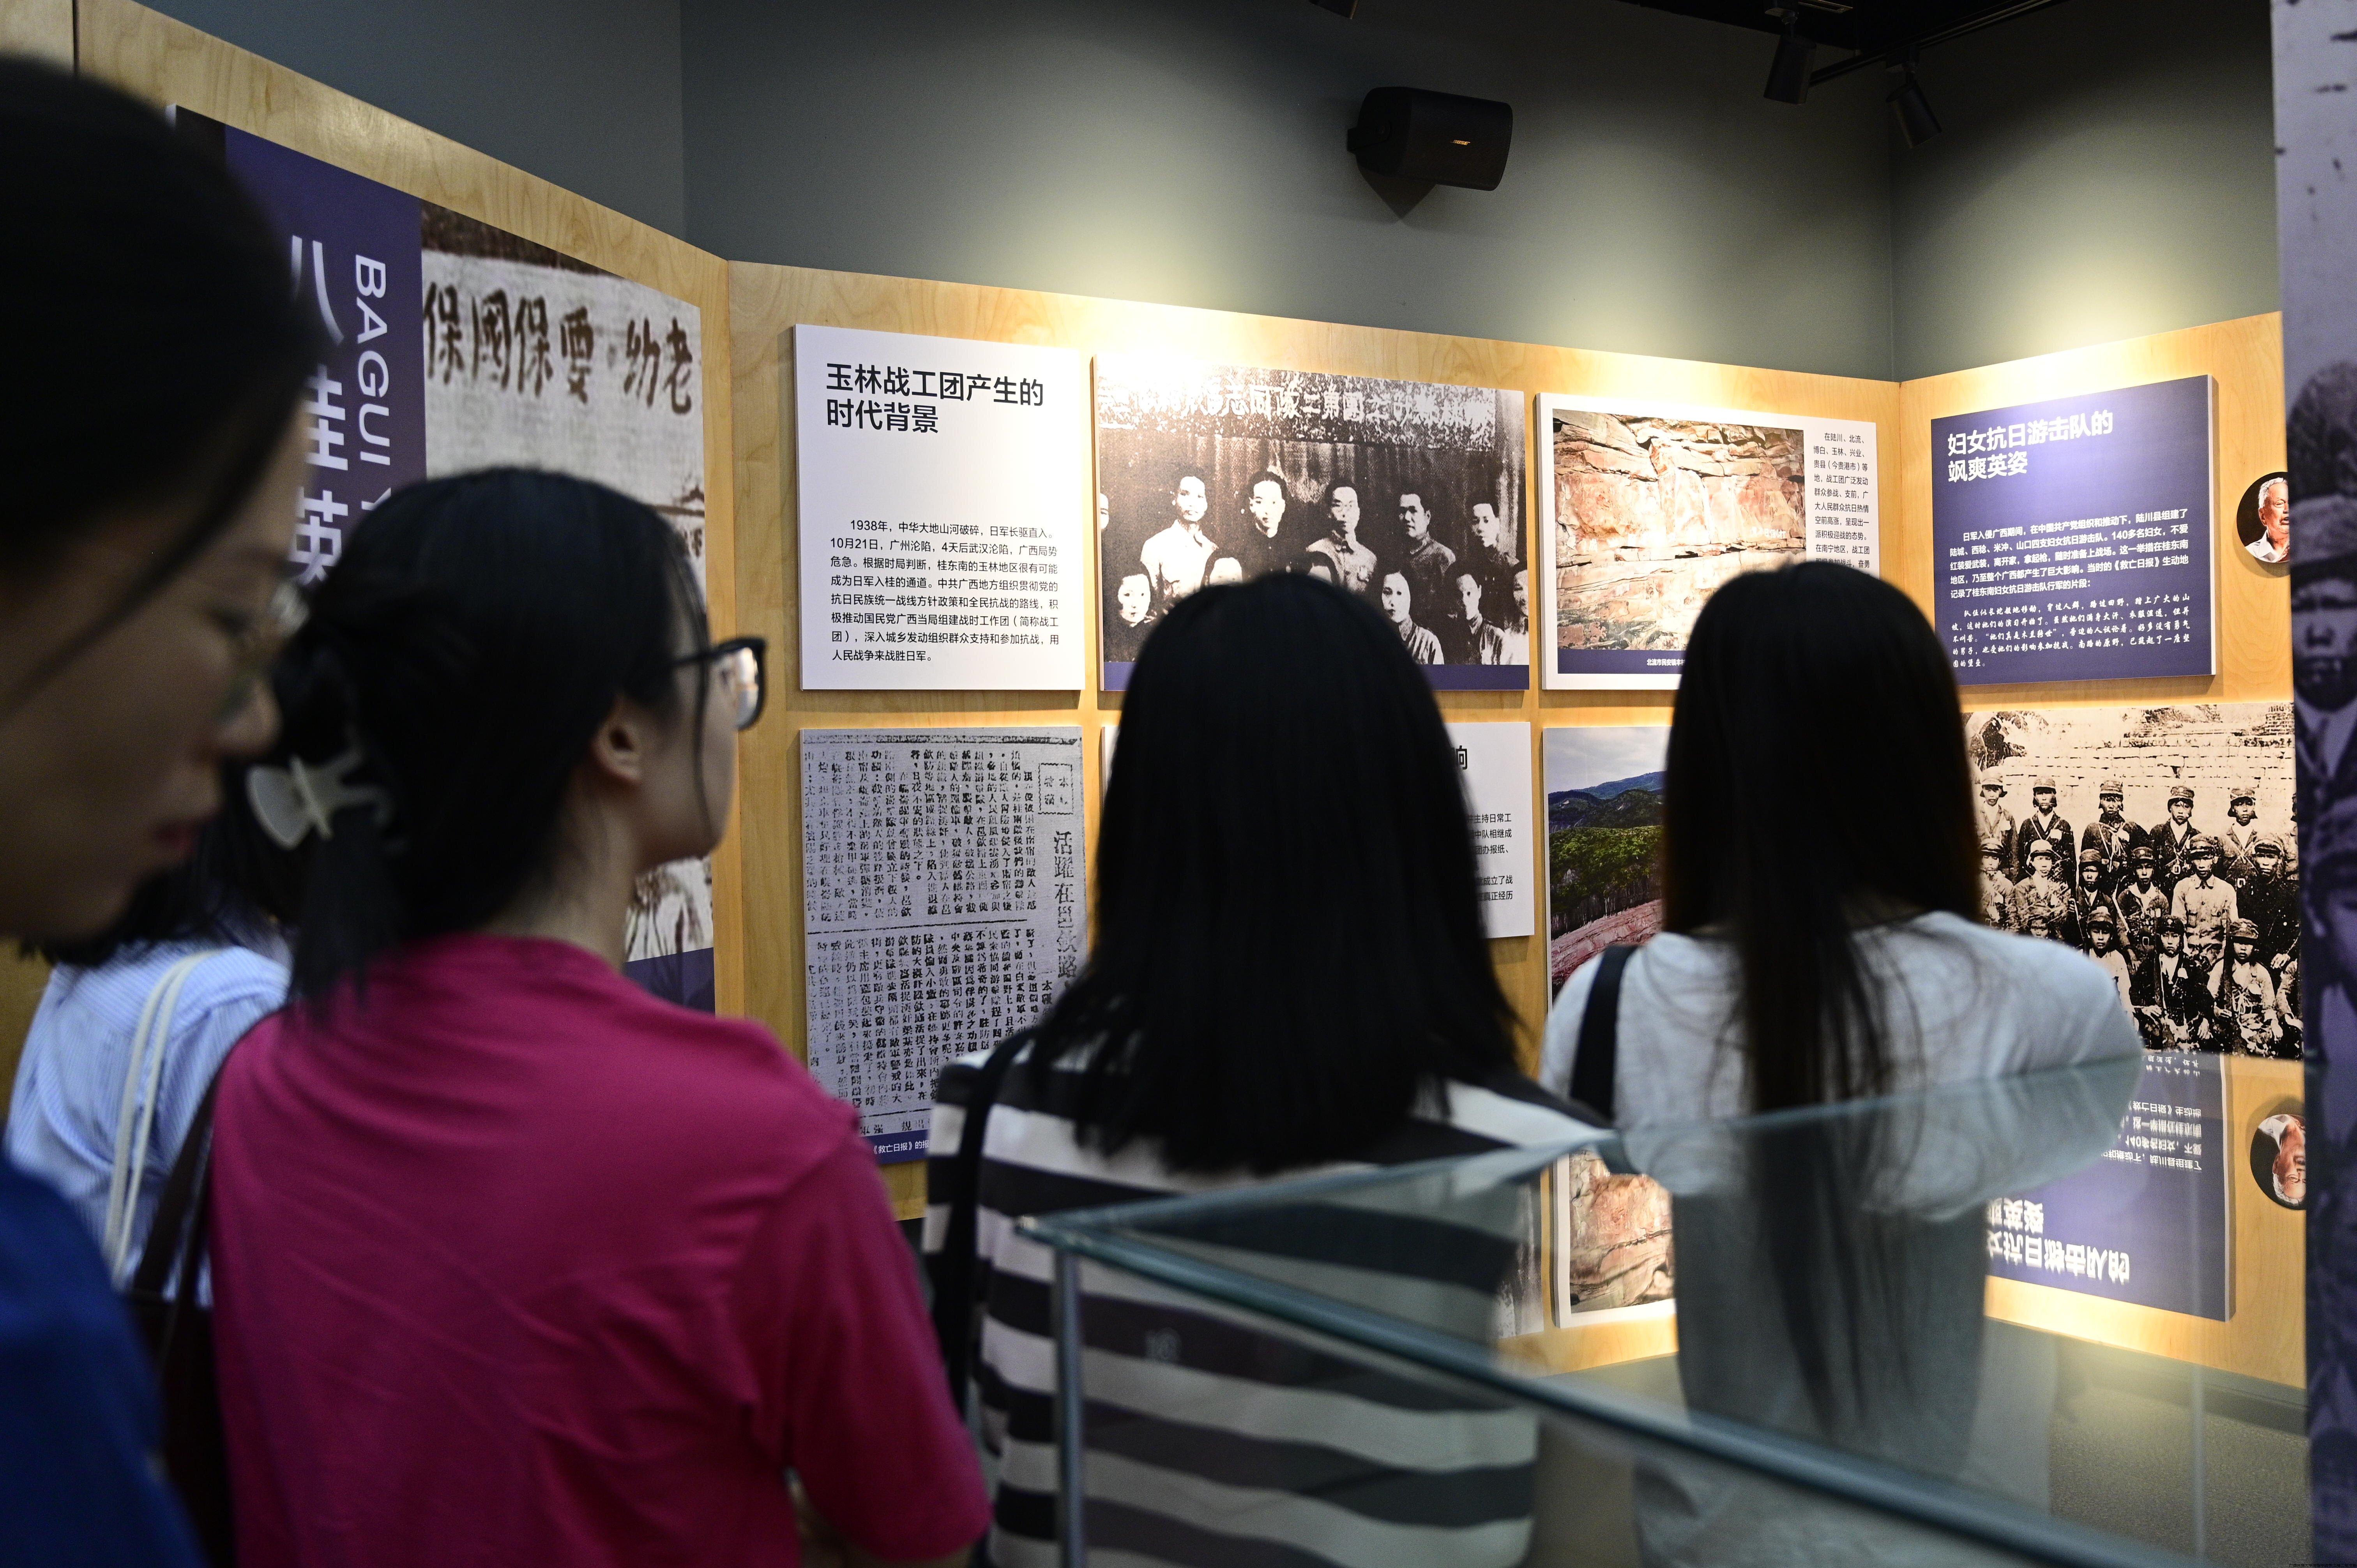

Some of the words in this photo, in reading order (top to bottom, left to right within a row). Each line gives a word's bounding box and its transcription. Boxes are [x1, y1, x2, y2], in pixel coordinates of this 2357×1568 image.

[355, 254, 390, 466] BAGUI
[827, 363, 1043, 406] 玉林战工团产生的
[828, 398, 938, 433] 时代背景
[1825, 433, 1865, 443] 在陆川、北流、
[1948, 409, 2113, 456] 妇女抗日游击队的
[1813, 446, 1865, 457] 博白、玉林、兴业、
[1814, 460, 1868, 471] 贵县（今贵港市）等
[1948, 451, 2028, 483] 飒爽英姿
[1814, 474, 1868, 485] 地，战工团广泛发动
[1815, 488, 1869, 499] 群众参战、支前，广
[1815, 502, 1869, 513] 大人民群众抗日热情
[1815, 516, 1869, 526] 空前高涨，呈现出一
[1963, 509, 2188, 542] 日军入侵广西期间，在中国共产党组织和推动下，陆川县组建了
[850, 520, 1053, 539] 1938年，中华大地山河破碎，日军长驱直入。
[1815, 530, 1867, 540] 派积极迎战的态势。
[830, 538, 1057, 557] 10月21日，广州沦陷，4天后武汉沦陷，广西局势
[1816, 544, 1870, 554] 在南宁地区，战工团
[1950, 539, 2189, 570] 红装爱武装，离开家，拿起枪，随时准备上战场。这一举措在桂东南
[830, 556, 1058, 574] 危急。根据时局判断，桂东南的玉林地区很有可能
[1951, 554, 2189, 585] 地区，乃至整个广西都产生了巨大影响。当时的《救亡日报》生动地
[831, 576, 1058, 592] 成为日军入桂的通道。中共广西地方组织贯彻党的
[1951, 579, 2090, 599] 记录了桂东南妇女抗日游击队行军的片段：
[831, 594, 1058, 610] 抗日民族统一战线方针政策和全民抗战的路线，积
[831, 613, 1058, 628] 极推动国民党广西当局组建战时工作团（简称战工
[832, 631, 1059, 645] 团），深入城乡发动组织群众支持和参加抗战，用
[832, 650, 932, 661] 人民战争来战胜日军。
[1953, 659, 1985, 668] 固的堡垒。
